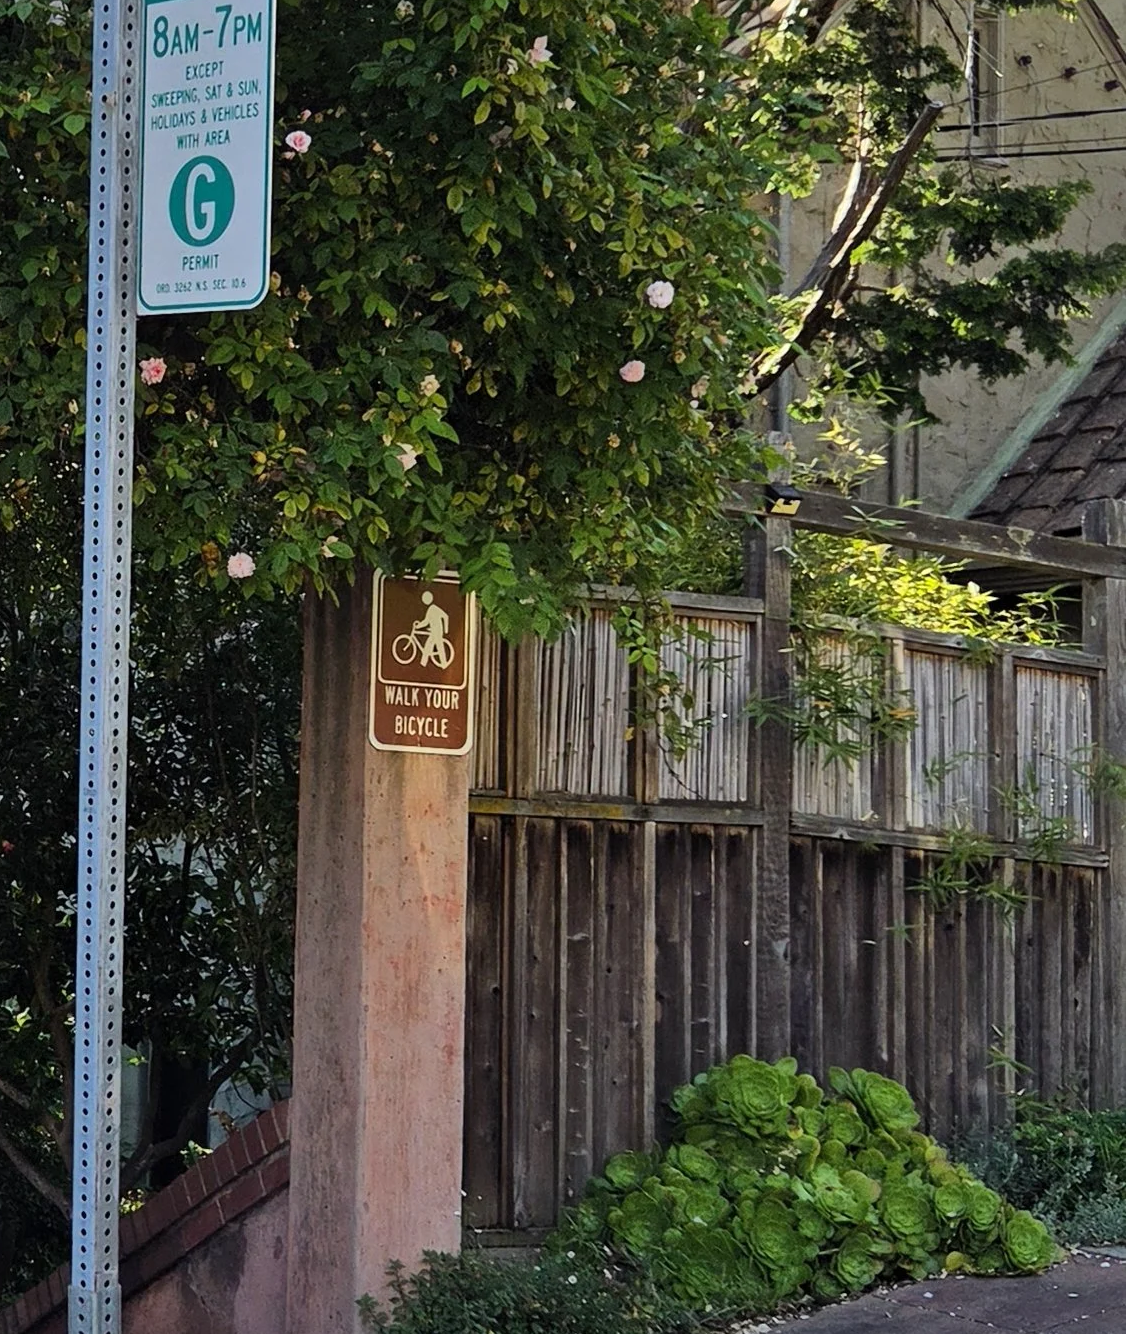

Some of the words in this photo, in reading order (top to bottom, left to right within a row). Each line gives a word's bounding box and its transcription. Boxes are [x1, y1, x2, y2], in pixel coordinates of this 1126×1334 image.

[185, 60, 224, 81] EXCEPT
[151, 88, 201, 109] SWEEPING,
[205, 83, 221, 101] SAT
[226, 82, 233, 97] &
[150, 110, 195, 131] HOLIDAYS
[200, 109, 207, 124] &
[211, 102, 259, 122] VEHICLES
[176, 131, 199, 150] WITH
[204, 128, 231, 146] AREA
[185, 162, 216, 241] G
[181, 254, 219, 271] PERMIT
[385, 686, 419, 706] WALK
[425, 691, 459, 710] YOUR
[395, 715, 449, 738] BICYCLE
